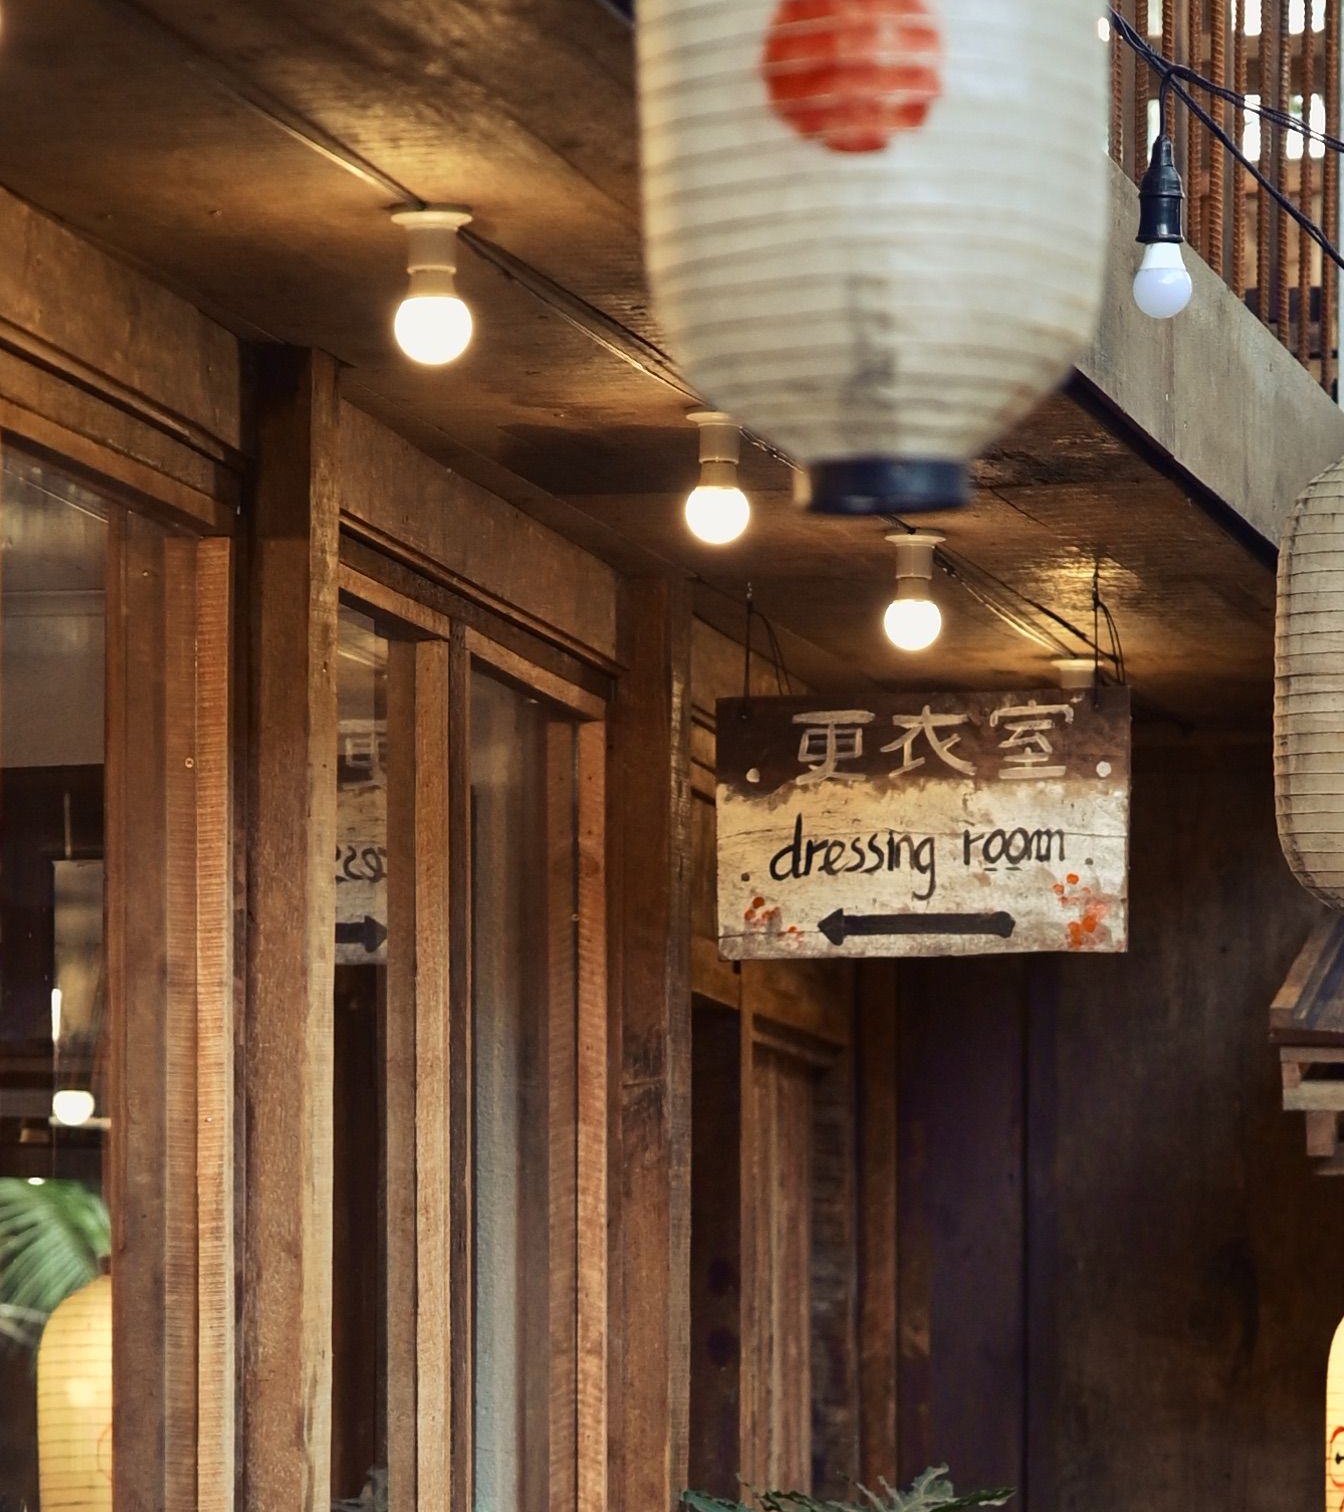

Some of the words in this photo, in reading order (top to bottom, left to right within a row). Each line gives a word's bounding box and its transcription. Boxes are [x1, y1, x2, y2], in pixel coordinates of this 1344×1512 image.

[791, 700, 1074, 785] 更衣室
[769, 813, 936, 900] dressing
[962, 826, 1065, 871] room
